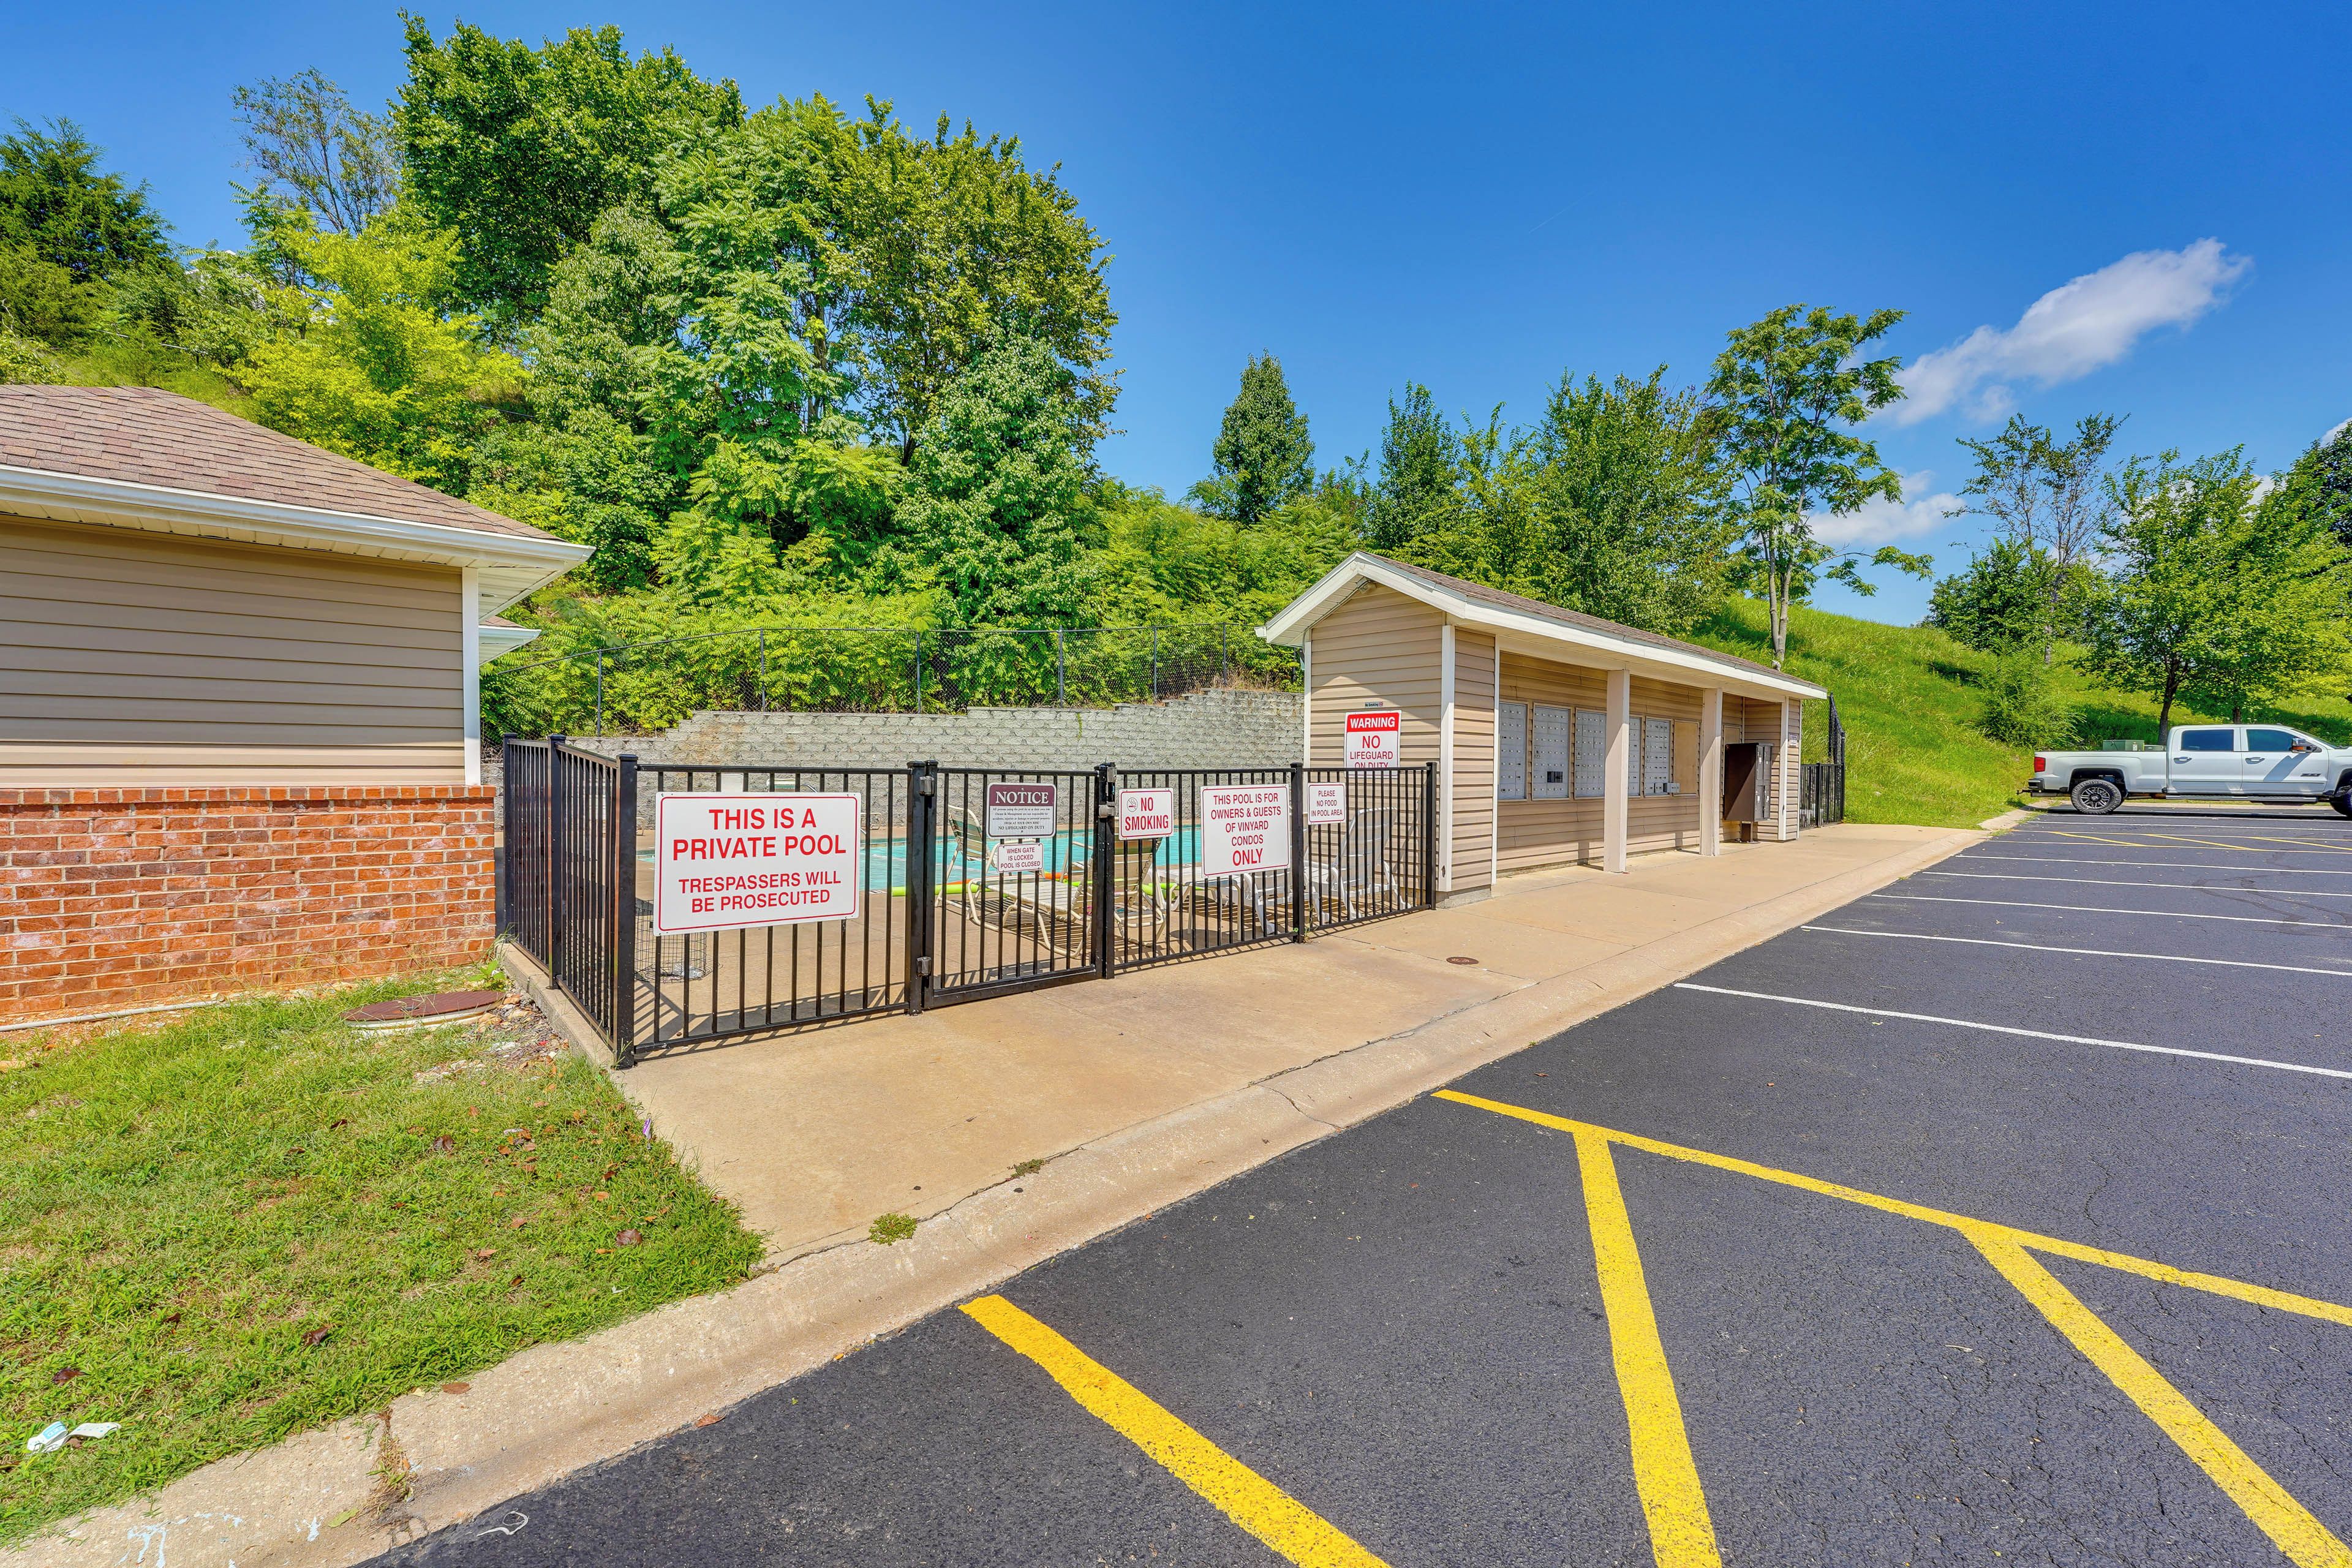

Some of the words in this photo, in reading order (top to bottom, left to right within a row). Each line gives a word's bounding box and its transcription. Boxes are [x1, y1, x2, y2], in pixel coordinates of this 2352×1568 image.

[1350, 717, 1395, 728] WARNING
[1362, 735, 1380, 748] NO
[995, 791, 1049, 804] NOTICE
[1140, 797, 1153, 812] NO
[1214, 794, 1231, 805] THIS
[1234, 794, 1253, 804] POOL
[1255, 794, 1262, 803] IS
[1264, 793, 1278, 802] FOR
[709, 809, 765, 830] THIS
[774, 809, 794, 829] IS
[801, 809, 816, 828] A
[1211, 809, 1244, 820] OWNERS
[1246, 809, 1251, 817] &
[1253, 806, 1281, 816] GUESTS
[1125, 815, 1169, 831] SMOKING
[1226, 823, 1235, 833] OF
[1237, 821, 1268, 832] VINYARD
[674, 837, 776, 860] PRIVATE
[785, 835, 846, 856] POOL
[1232, 835, 1263, 846] CONDOS
[1232, 848, 1263, 866] ONLY
[679, 873, 800, 894] TRESPASSERS
[805, 871, 841, 886] WILL
[692, 898, 714, 913] BE
[721, 889, 830, 911] PROSECUTED
